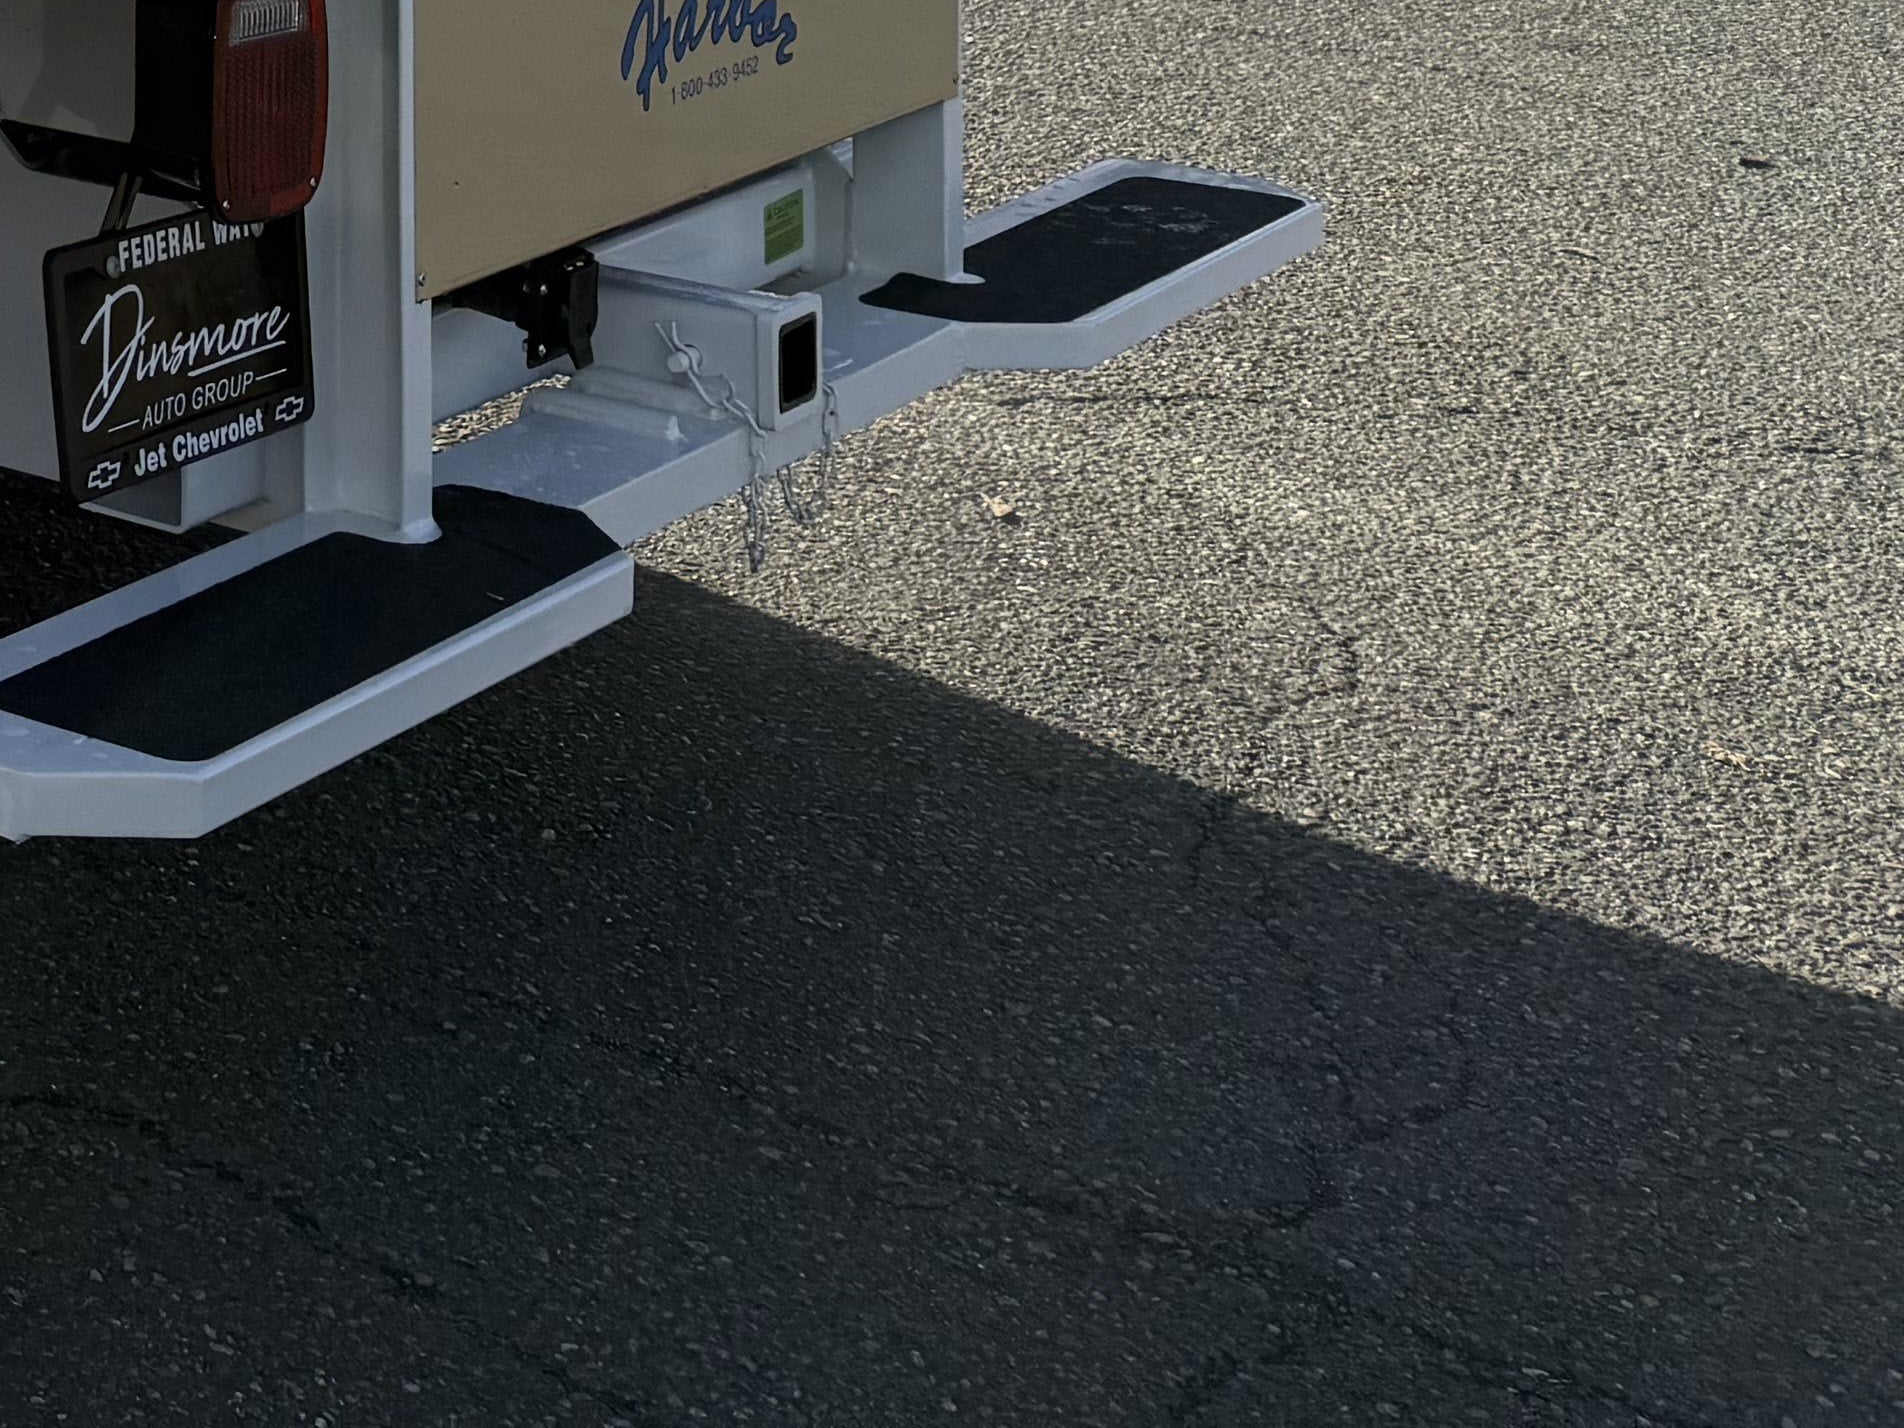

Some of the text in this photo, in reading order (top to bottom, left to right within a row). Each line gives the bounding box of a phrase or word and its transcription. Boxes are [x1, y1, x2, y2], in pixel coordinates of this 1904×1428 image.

[118, 220, 205, 273] FEDERAL
[80, 283, 290, 433] Dinsmore
[142, 370, 254, 431] AUTO GROUP
[134, 408, 265, 477] Jet Chevrolet
